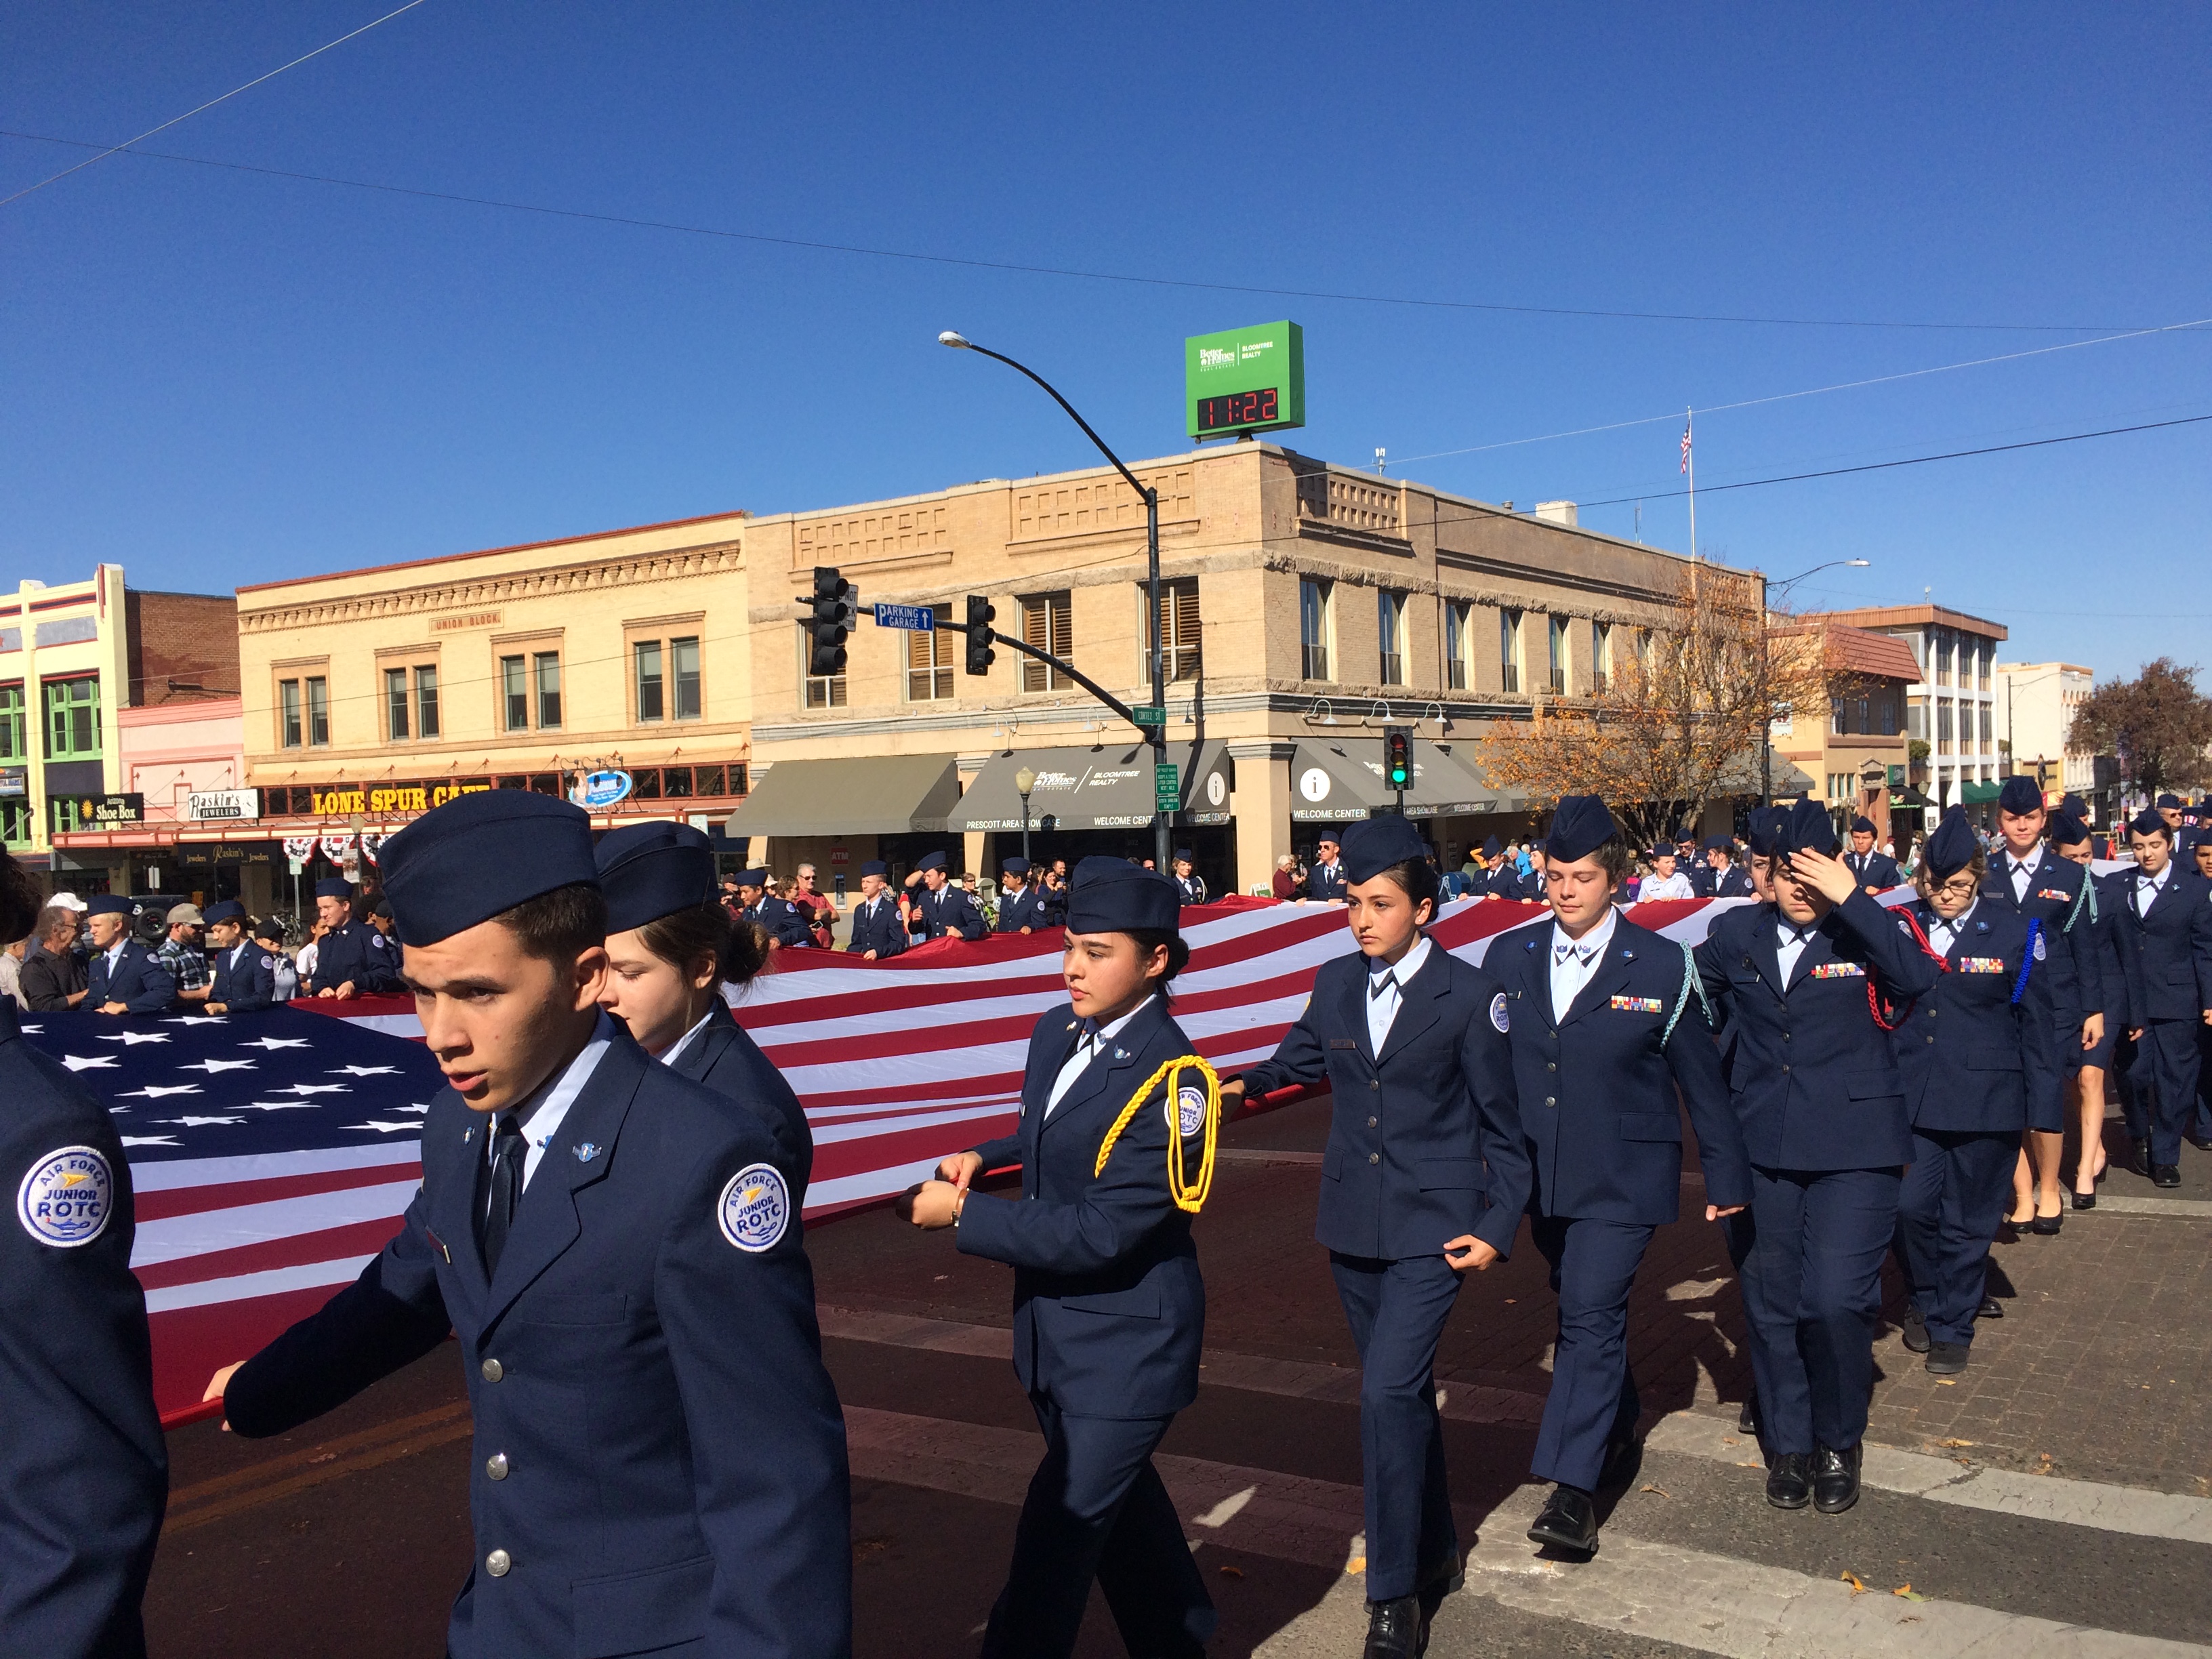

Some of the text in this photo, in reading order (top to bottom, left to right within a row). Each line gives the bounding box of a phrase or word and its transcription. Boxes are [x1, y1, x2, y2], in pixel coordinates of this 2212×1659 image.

[1242, 341, 1273, 352] BLOOMTREE
[1200, 348, 1223, 359] Better
[1207, 352, 1235, 365] Homes
[1242, 350, 1261, 359] REALTY
[1209, 389, 1276, 426] 11:22
[879, 605, 919, 626] PARKING
[436, 618, 463, 630] UNION
[888, 617, 920, 629] GARAGE
[1138, 711, 1153, 720] CORTEZ
[1036, 771, 1067, 780] Better
[1093, 770, 1141, 779] BLOOMTREE
[1042, 776, 1078, 786] Homes
[189, 793, 240, 818] Raskin's
[313, 785, 490, 815] LONE SPUR CA
[96, 804, 136, 820] Shoe Box
[1453, 802, 1485, 812] WELCOME CENTER
[201, 808, 239, 818] JEWELERS
[1187, 813, 1230, 823] WELCOME CENTER
[1293, 808, 1366, 819] WELCOME CENTER
[966, 820, 1001, 830] PRESCOTT
[1002, 819, 1019, 829] AREA
[1094, 815, 1156, 825] WELCOME CENTE
[186, 844, 269, 864] Jewelers Raskin's Jewelers
[832, 852, 848, 860] ATM
[1188, 1094, 1201, 1109] FORCE
[1180, 1106, 1197, 1115] UNIOR
[1180, 1112, 1198, 1124] OTC
[40, 1160, 105, 1187] AIR FORCE
[43, 1189, 97, 1200] JUNIOR
[730, 1175, 777, 1207] AIR FORCE
[37, 1201, 101, 1217] ROTC
[738, 1195, 774, 1218] JUNIOR
[736, 1203, 781, 1233] ROTC
